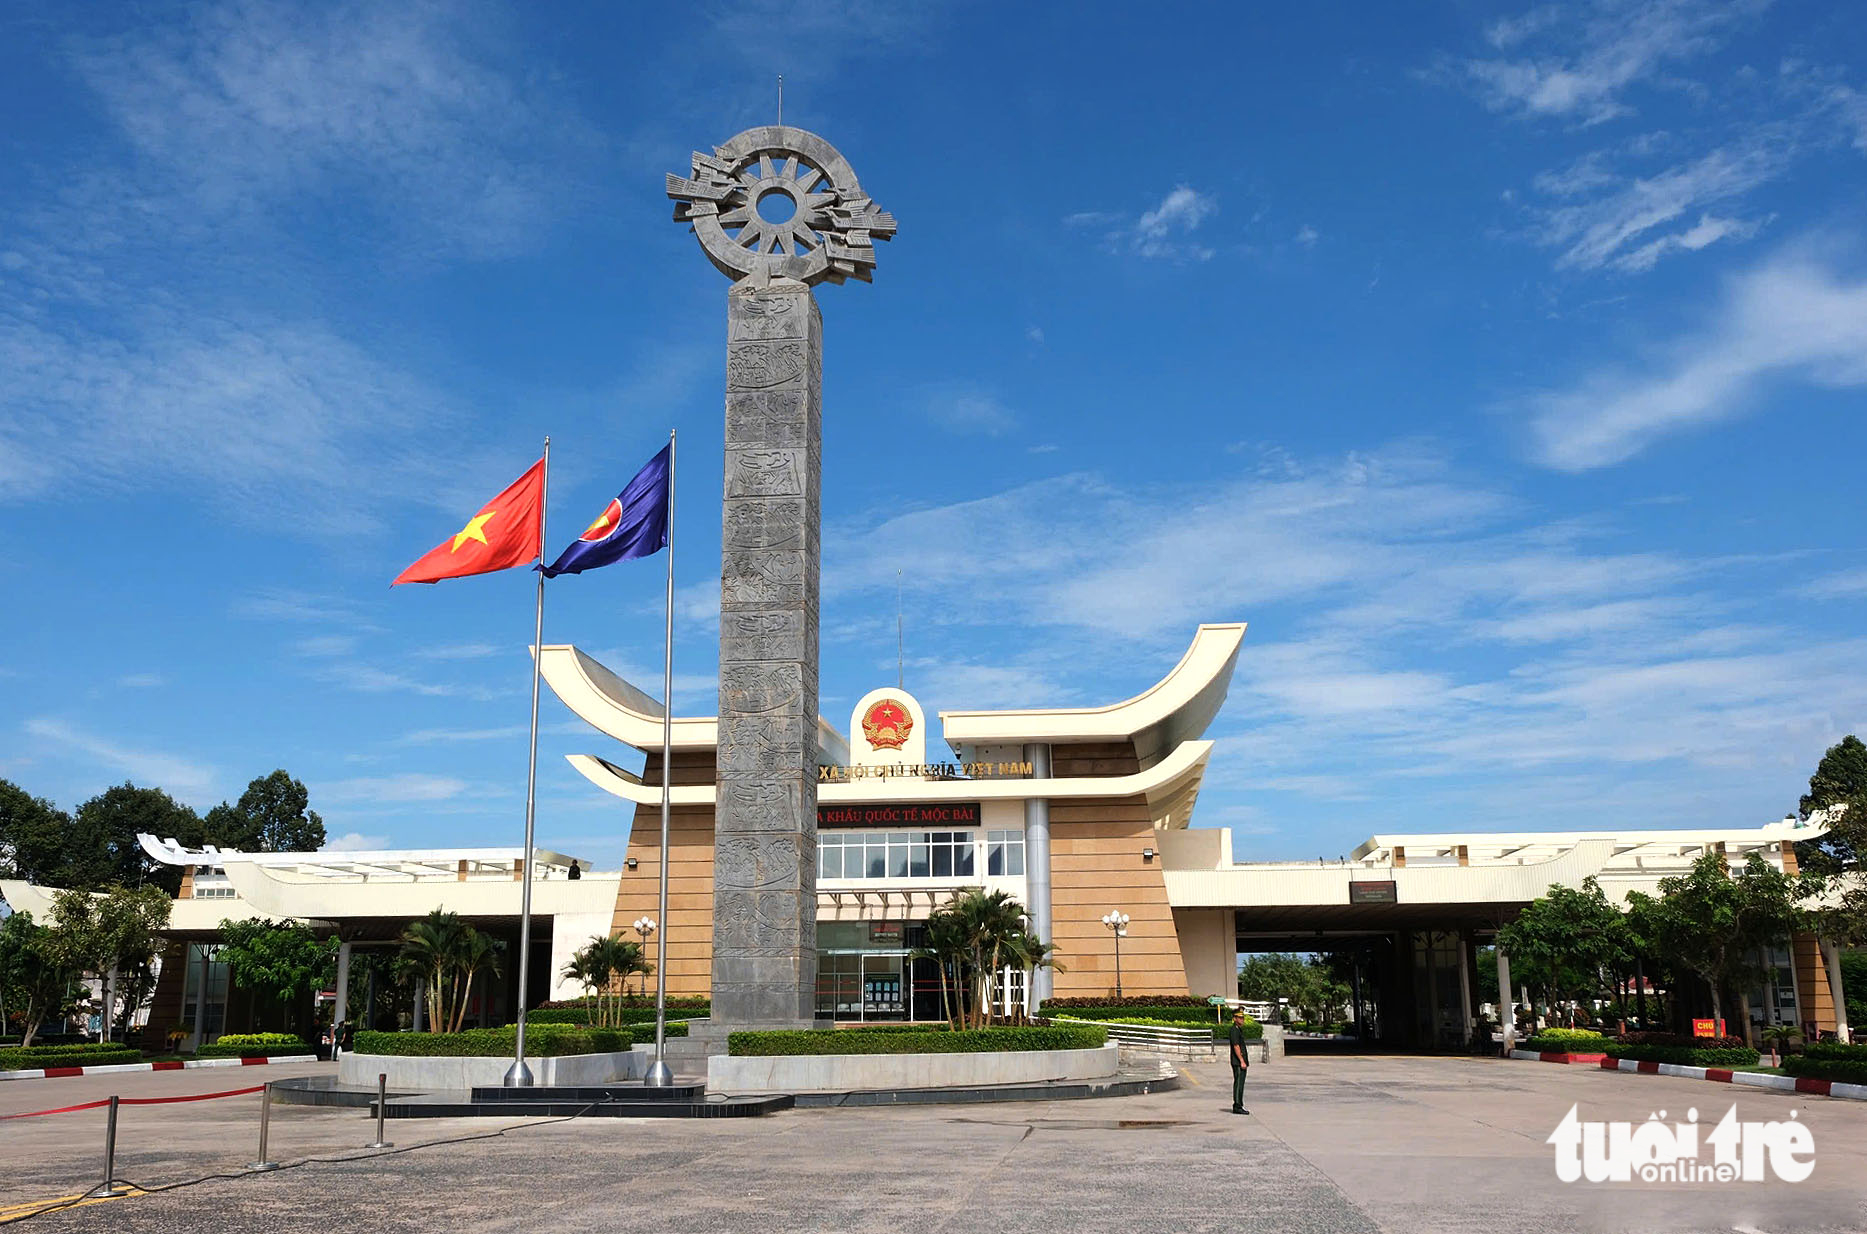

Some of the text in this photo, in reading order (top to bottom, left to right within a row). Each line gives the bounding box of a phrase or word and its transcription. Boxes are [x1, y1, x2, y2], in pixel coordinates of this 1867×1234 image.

[999, 761, 1033, 776] NAM
[865, 808, 900, 824] QUỐC
[921, 807, 949, 823] MỘC
[953, 806, 974, 820] BÀI
